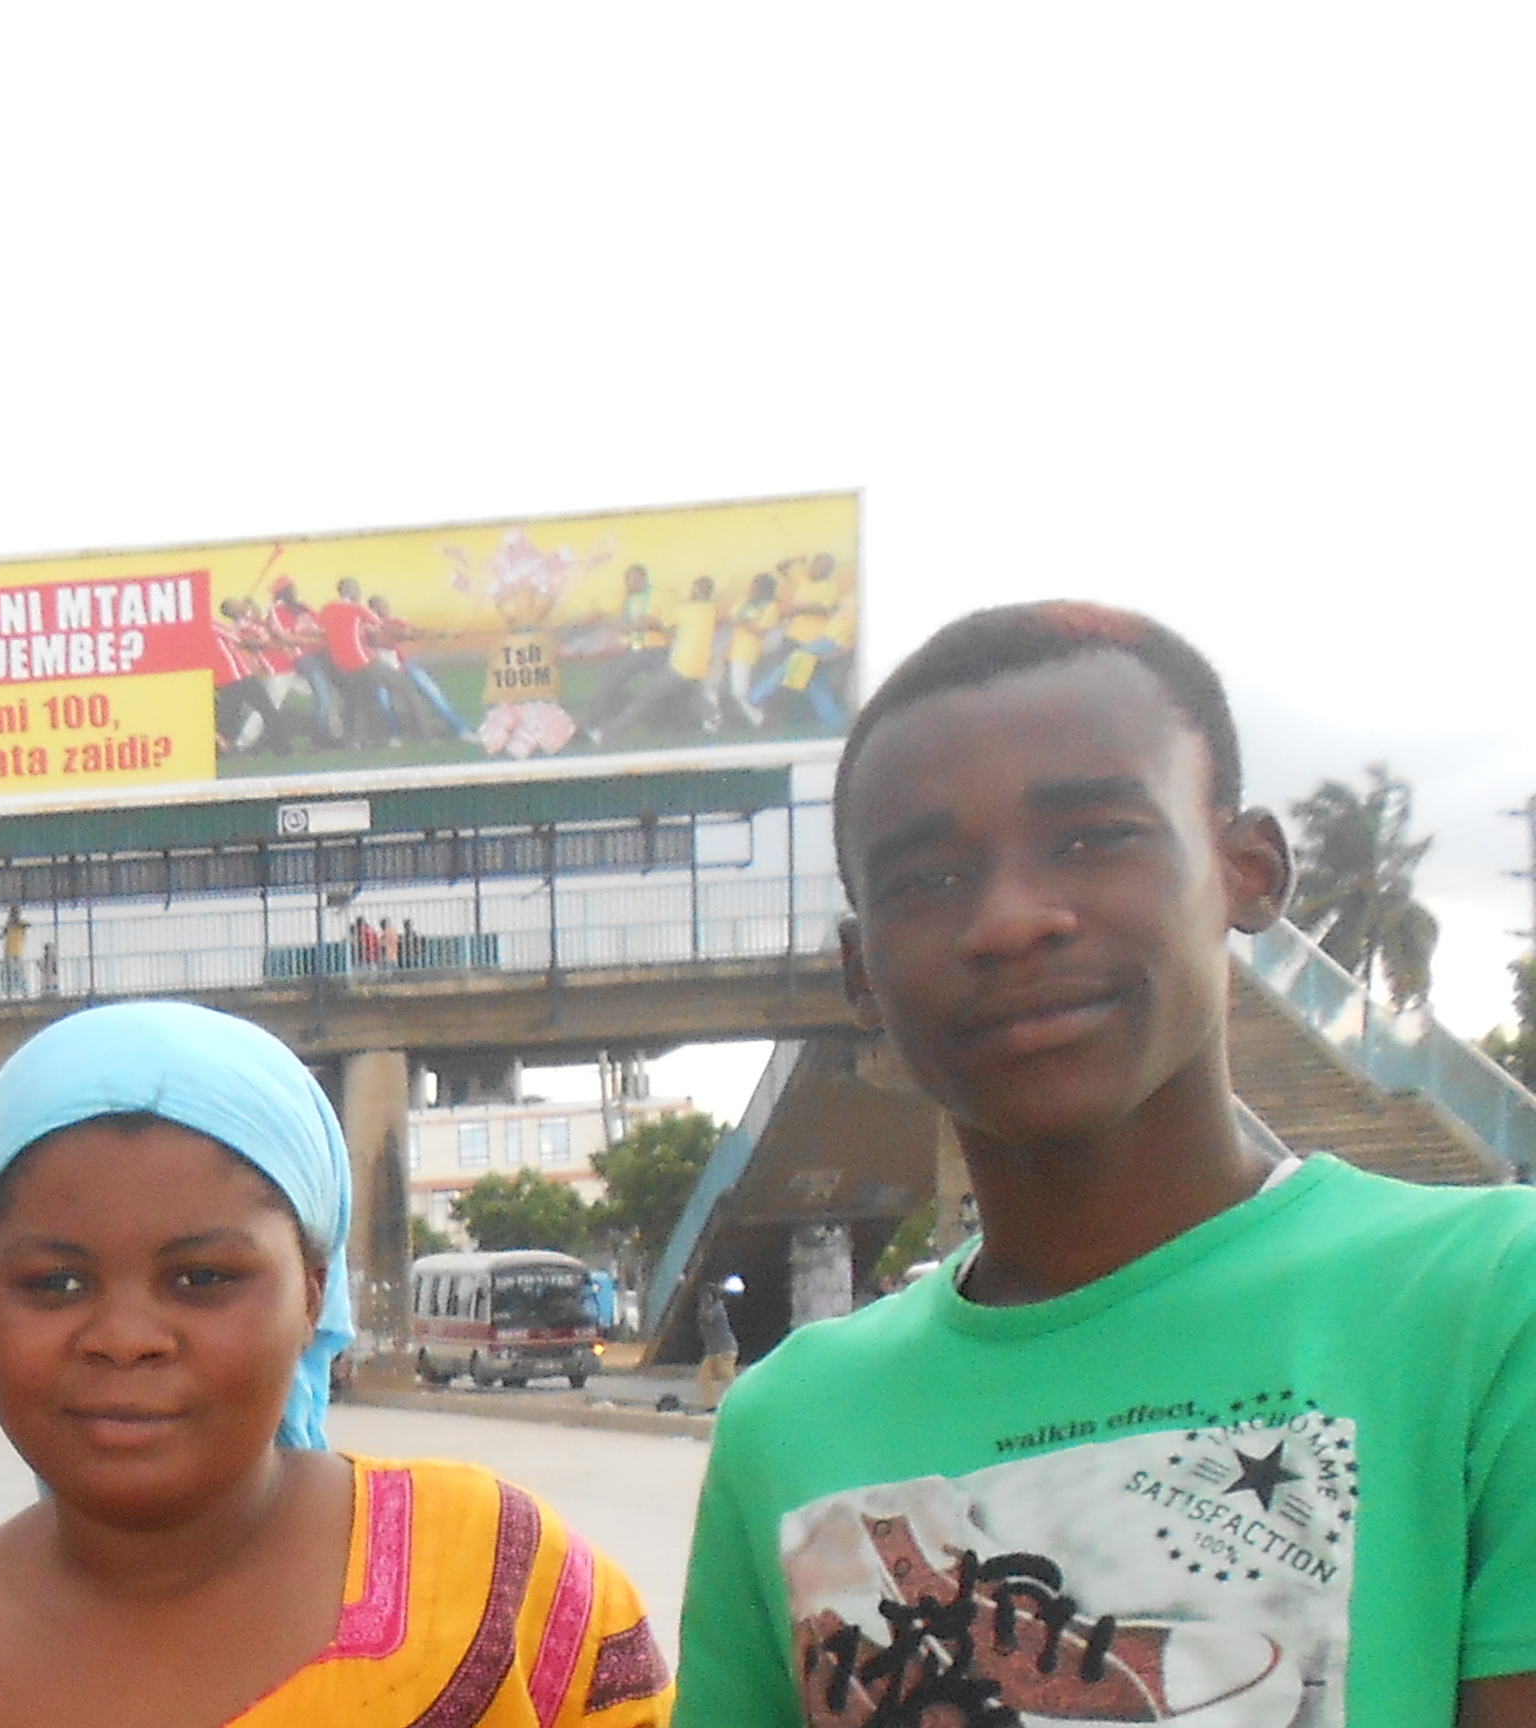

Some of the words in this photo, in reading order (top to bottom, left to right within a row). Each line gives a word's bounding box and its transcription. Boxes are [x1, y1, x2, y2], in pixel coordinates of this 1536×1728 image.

[56, 578, 194, 630] MTANI
[495, 666, 551, 688] 100M
[42, 692, 121, 731] 100,
[63, 734, 174, 774] zaidi?
[1124, 1469, 1337, 1584] SATISFACTION
[1192, 1530, 1239, 1565] 100%
